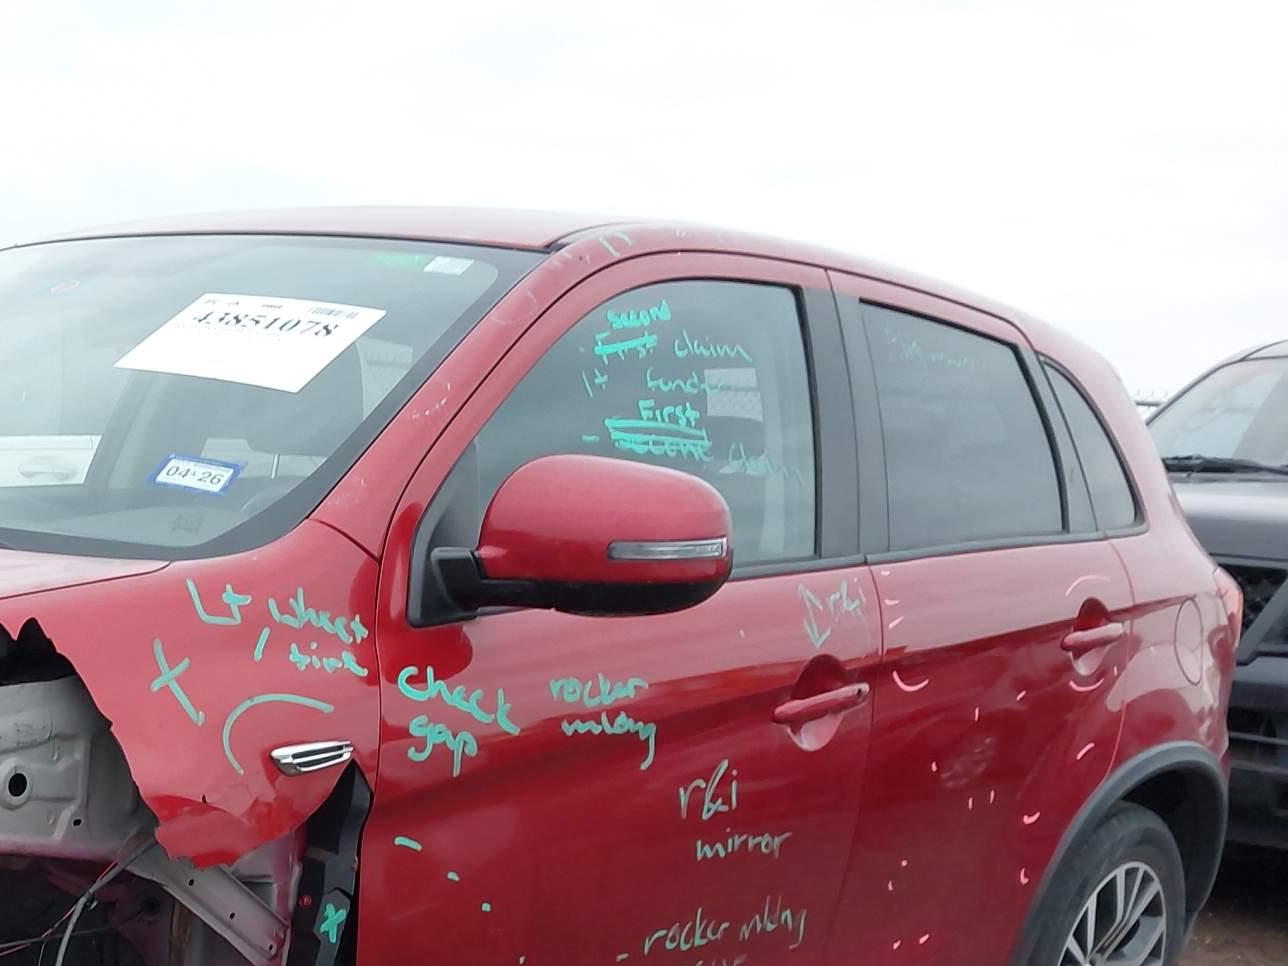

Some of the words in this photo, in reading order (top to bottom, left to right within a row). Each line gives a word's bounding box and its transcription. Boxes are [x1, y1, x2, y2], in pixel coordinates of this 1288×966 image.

[637, 399, 700, 426] First
[408, 714, 478, 778] gap
[696, 827, 792, 861] mirror
